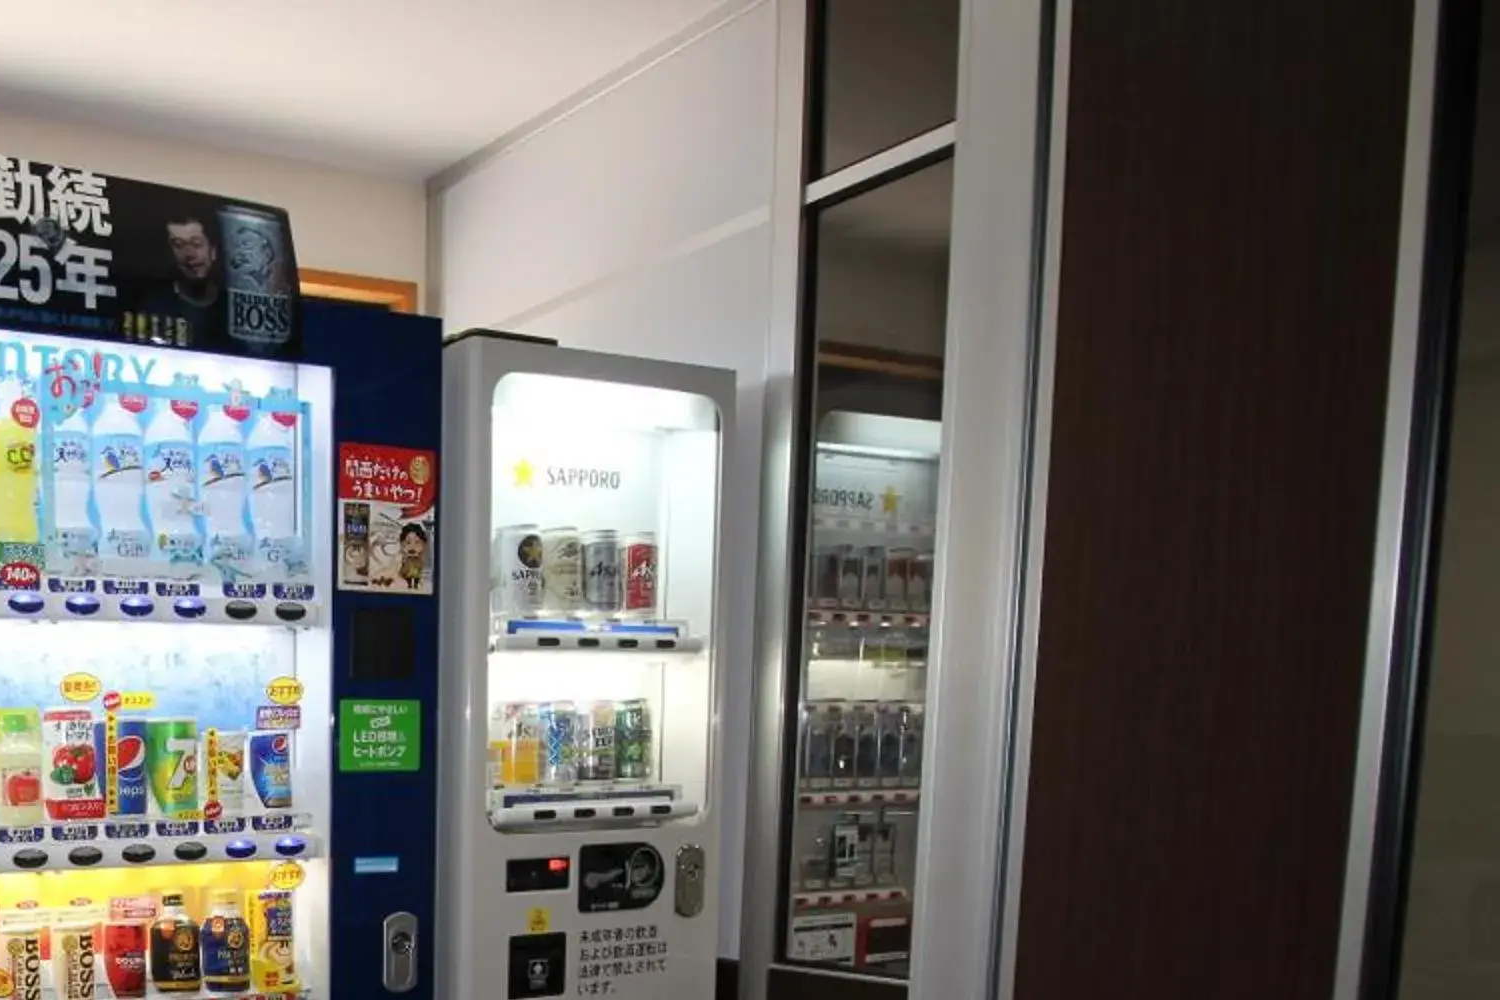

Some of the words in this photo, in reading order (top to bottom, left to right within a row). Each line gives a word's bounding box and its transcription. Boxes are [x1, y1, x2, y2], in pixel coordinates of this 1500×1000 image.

[234, 303, 290, 336] BOSS
[546, 466, 622, 490] SAPPORO
[79, 934, 94, 998] BOSS
